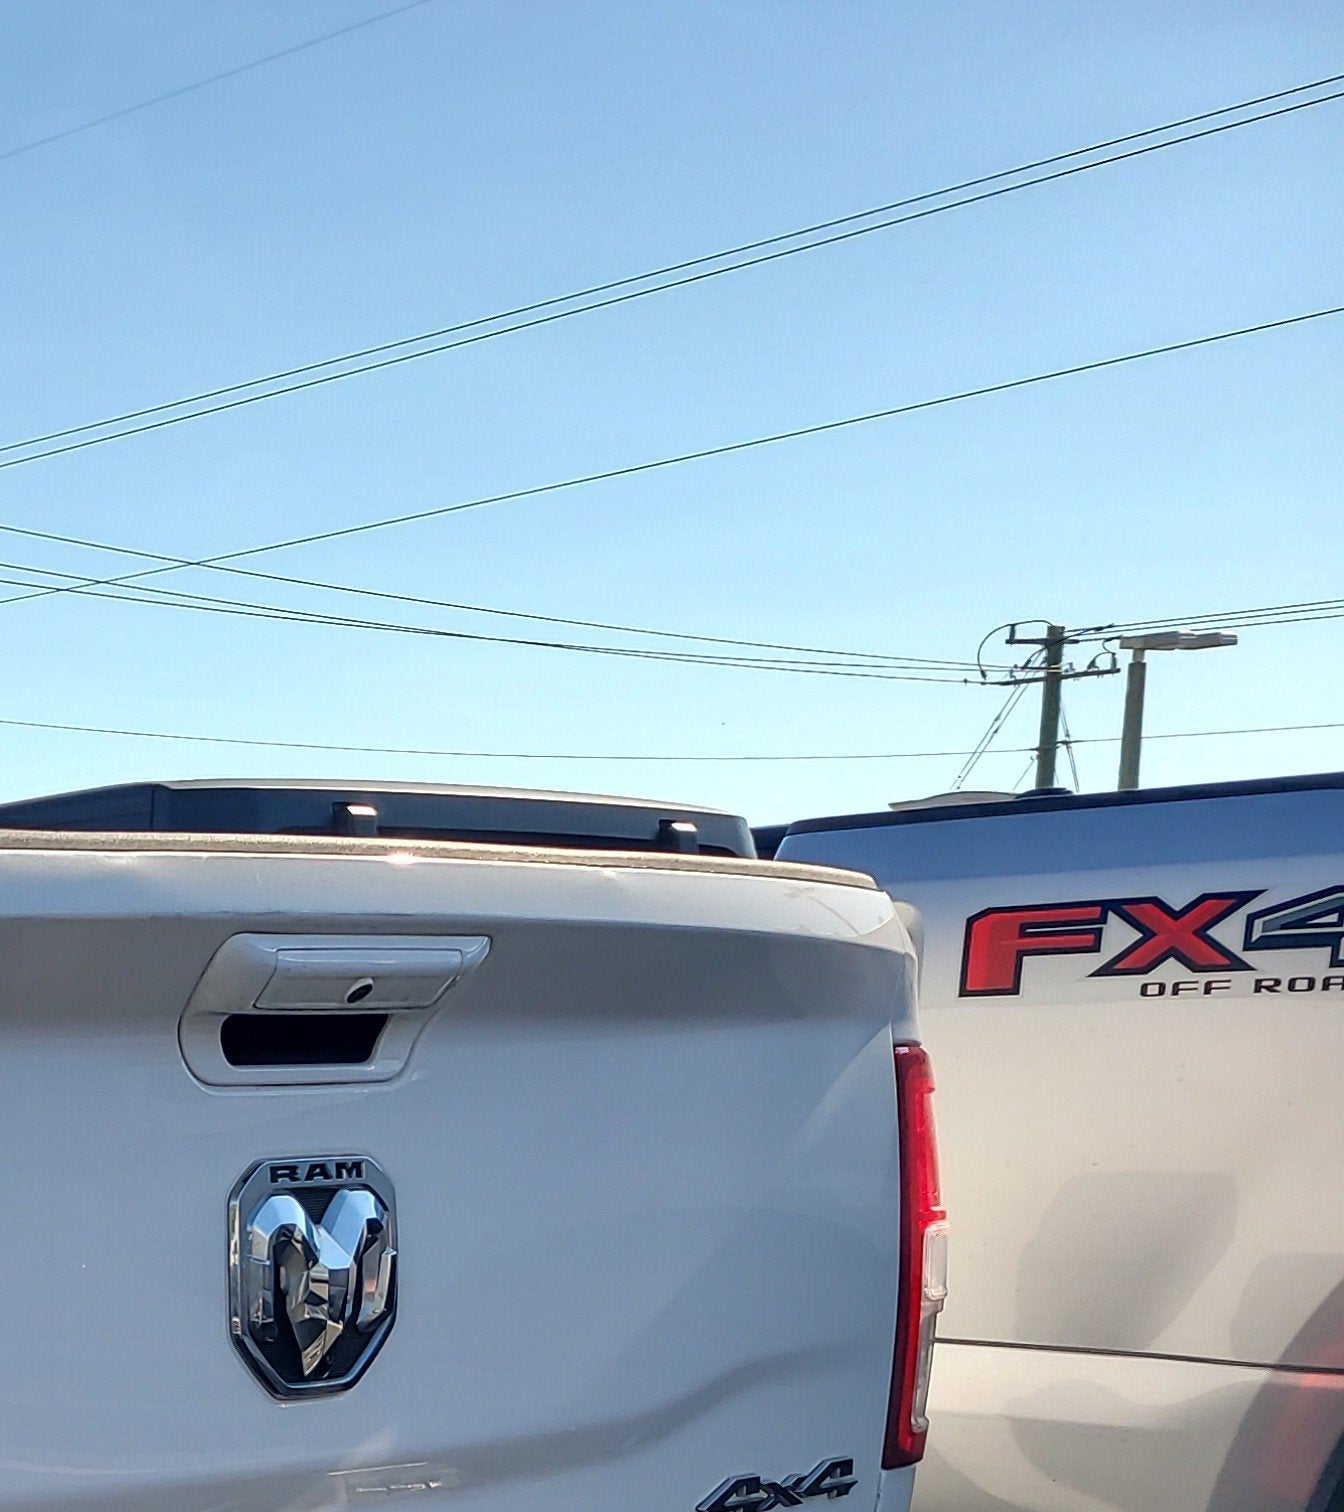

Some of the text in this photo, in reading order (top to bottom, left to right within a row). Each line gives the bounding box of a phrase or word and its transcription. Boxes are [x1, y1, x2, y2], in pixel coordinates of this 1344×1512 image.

[959, 885, 1344, 998] FX4
[1139, 979, 1231, 998] OFF
[269, 1160, 365, 1184] RAM
